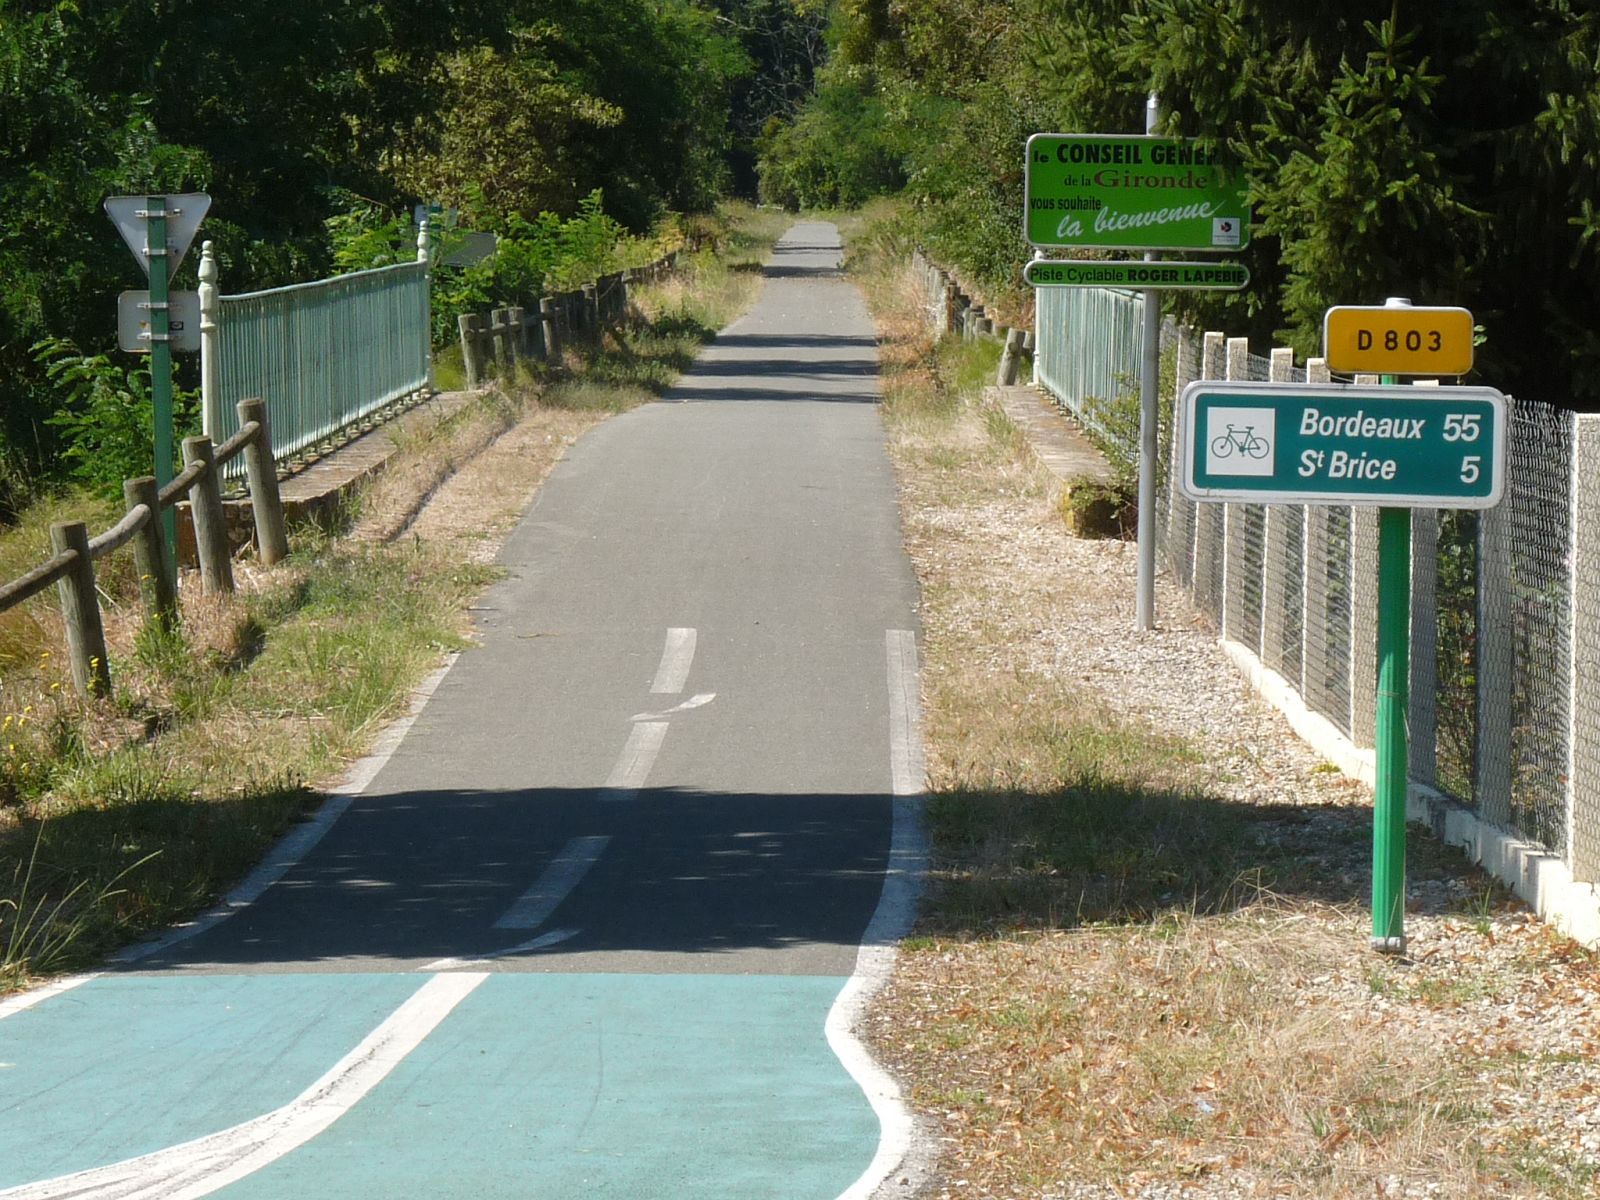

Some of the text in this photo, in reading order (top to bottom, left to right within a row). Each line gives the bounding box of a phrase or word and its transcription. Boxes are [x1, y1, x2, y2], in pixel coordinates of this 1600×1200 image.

[1033, 150, 1049, 163] le
[1057, 143, 1143, 164] CONSEIL
[1064, 169, 1208, 188] de la Gironde
[1031, 196, 1101, 210] vous souhaite
[1056, 200, 1225, 238] la bienvenue
[1030, 268, 1245, 284] Piste Cyclable ROGER LAPEBIE
[1358, 330, 1442, 352] D 803
[1300, 408, 1481, 442] Bordeaux 55
[1298, 449, 1481, 484] St Brice 5
